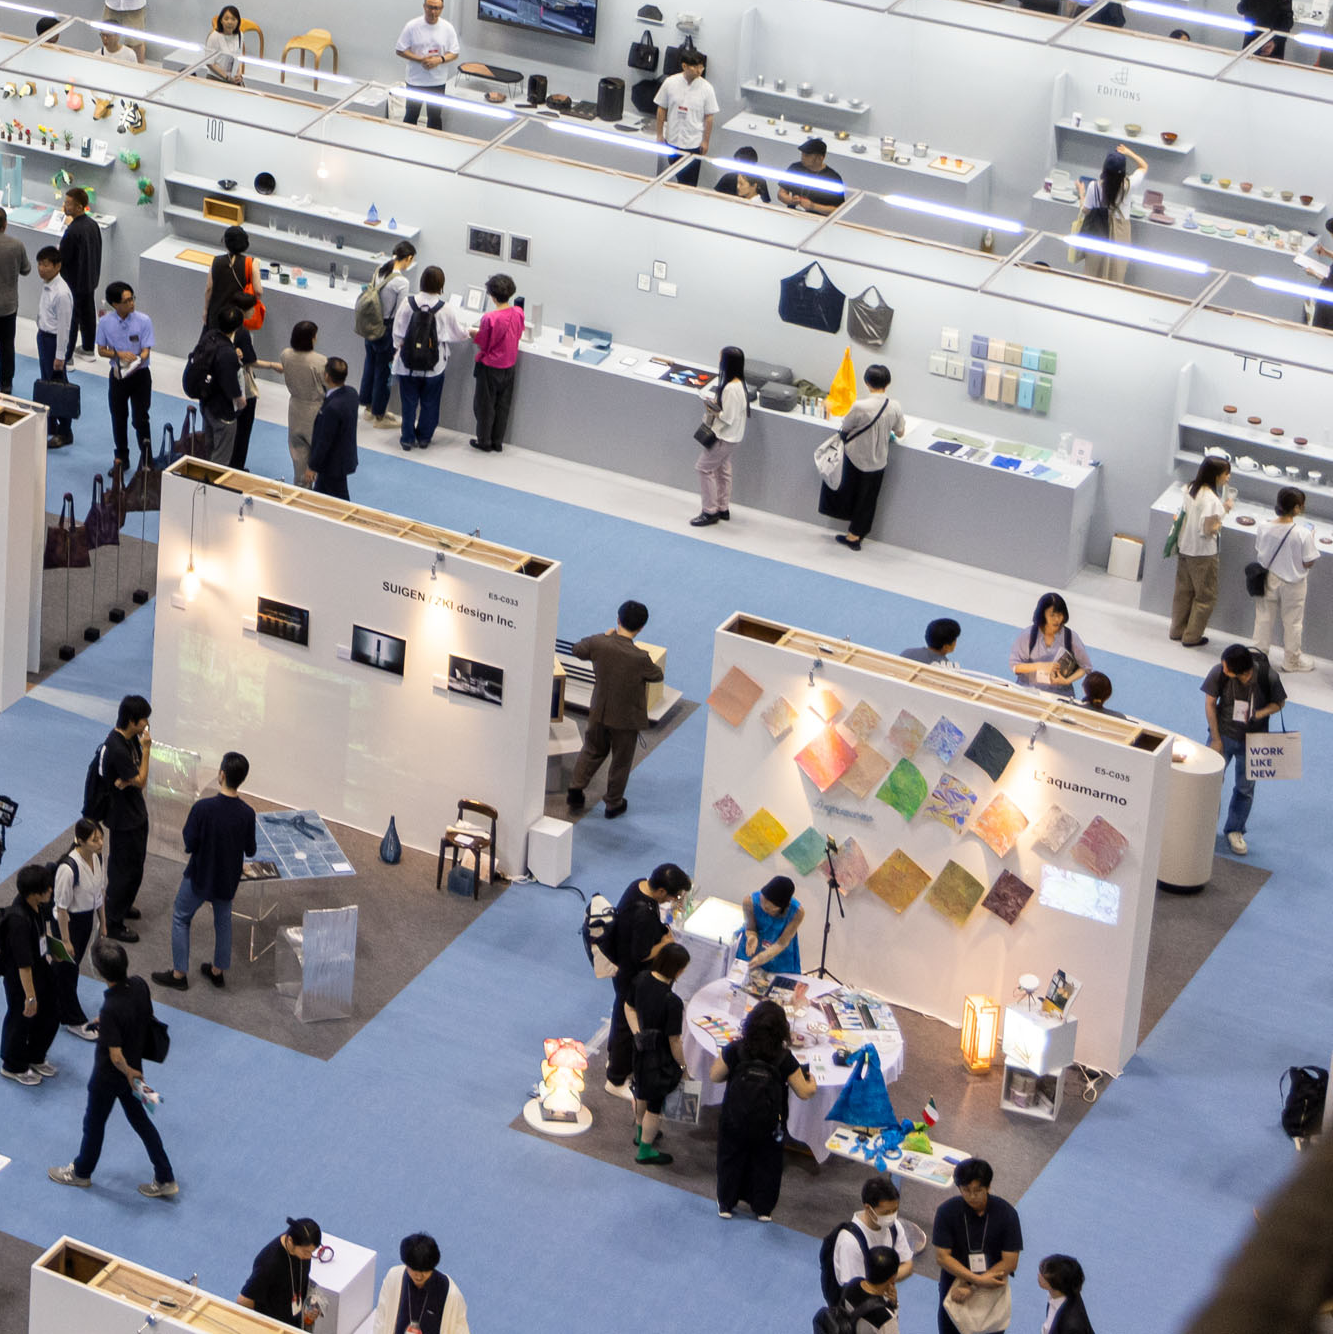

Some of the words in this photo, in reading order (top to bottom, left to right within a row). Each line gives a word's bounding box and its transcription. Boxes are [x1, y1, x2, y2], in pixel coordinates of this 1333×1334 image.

[1097, 84, 1141, 102] EDITIONS
[382, 581, 426, 602] SUIGEN
[456, 604, 493, 622] design
[496, 615, 517, 630] Inc.
[488, 592, 519, 607] E5-C033
[1249, 747, 1284, 756] WORK
[1250, 758, 1273, 767] LIKE
[1094, 766, 1131, 783] E5-C035
[1250, 769, 1276, 778] NEW
